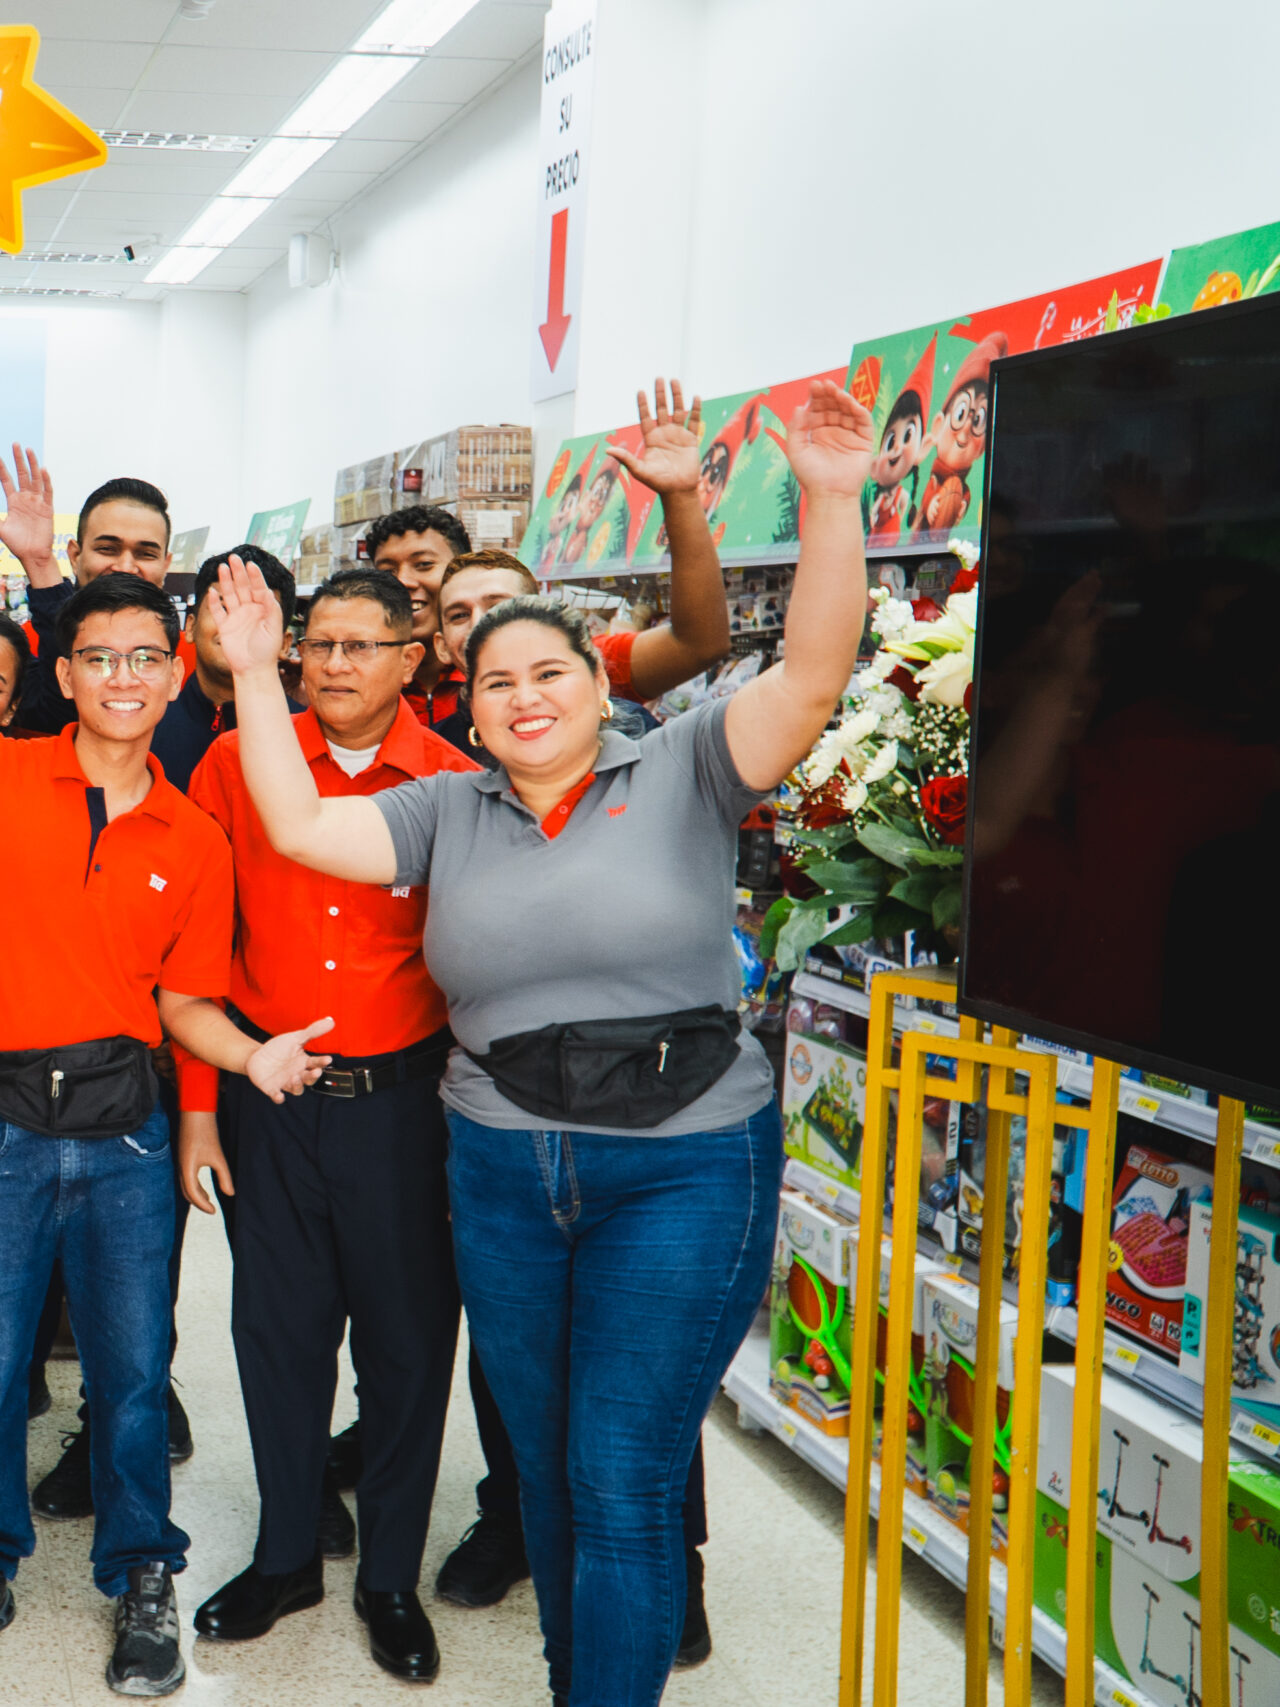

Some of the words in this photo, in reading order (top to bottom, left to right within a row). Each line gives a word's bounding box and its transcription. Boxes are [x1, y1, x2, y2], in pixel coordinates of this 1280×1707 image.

[545, 19, 592, 84] CONSULTE
[560, 93, 572, 134] SU
[545, 149, 579, 200] PRECIO
[1106, 1292, 1140, 1319] NGO
